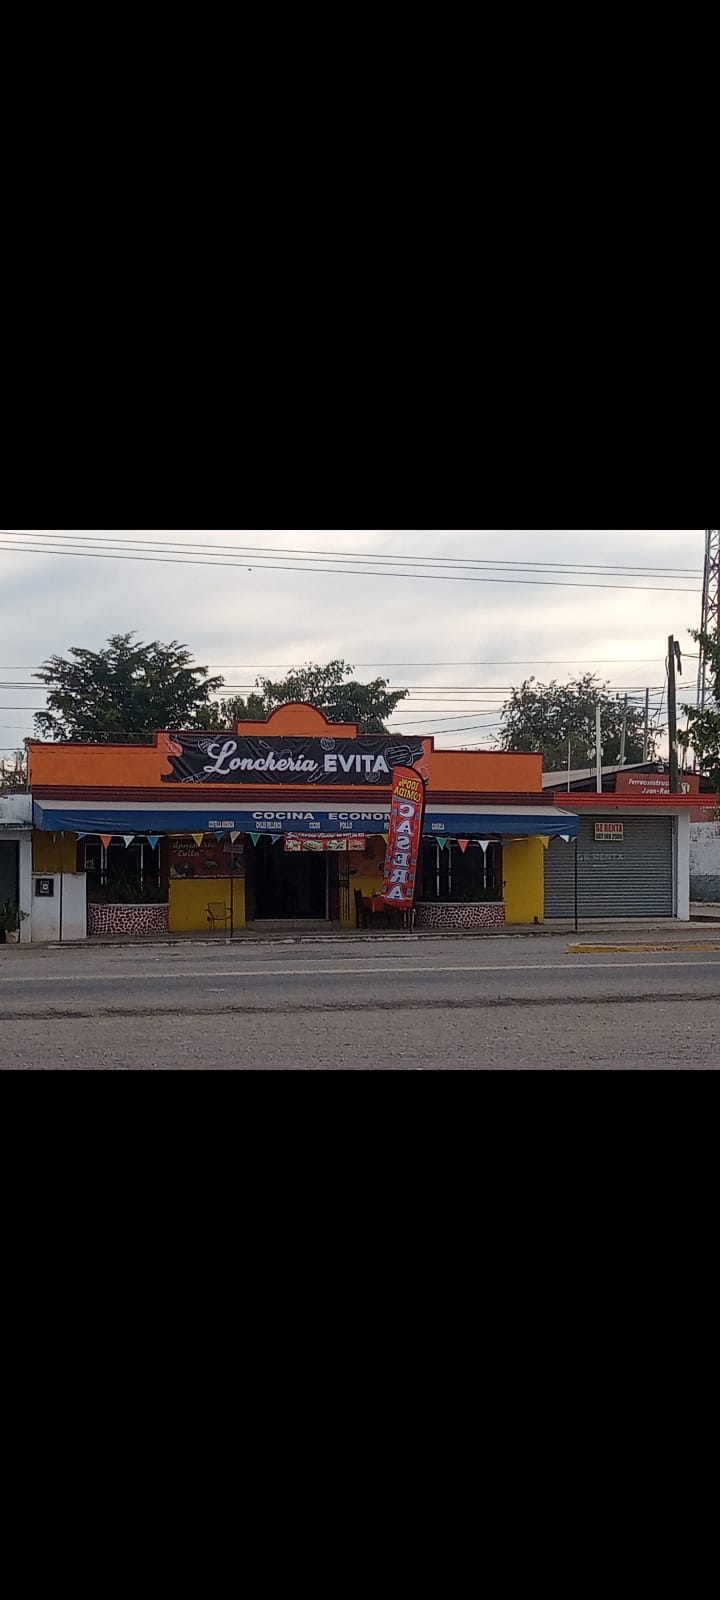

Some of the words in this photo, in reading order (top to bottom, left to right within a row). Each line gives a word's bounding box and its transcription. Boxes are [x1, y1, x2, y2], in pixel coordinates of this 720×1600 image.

[323, 754, 390, 774] EVITA
[252, 811, 315, 820] COCINA
[328, 812, 391, 821] ECONO
[339, 821, 353, 829] POLLO
[595, 823, 603, 833] SE
[604, 823, 622, 833] RENTA
